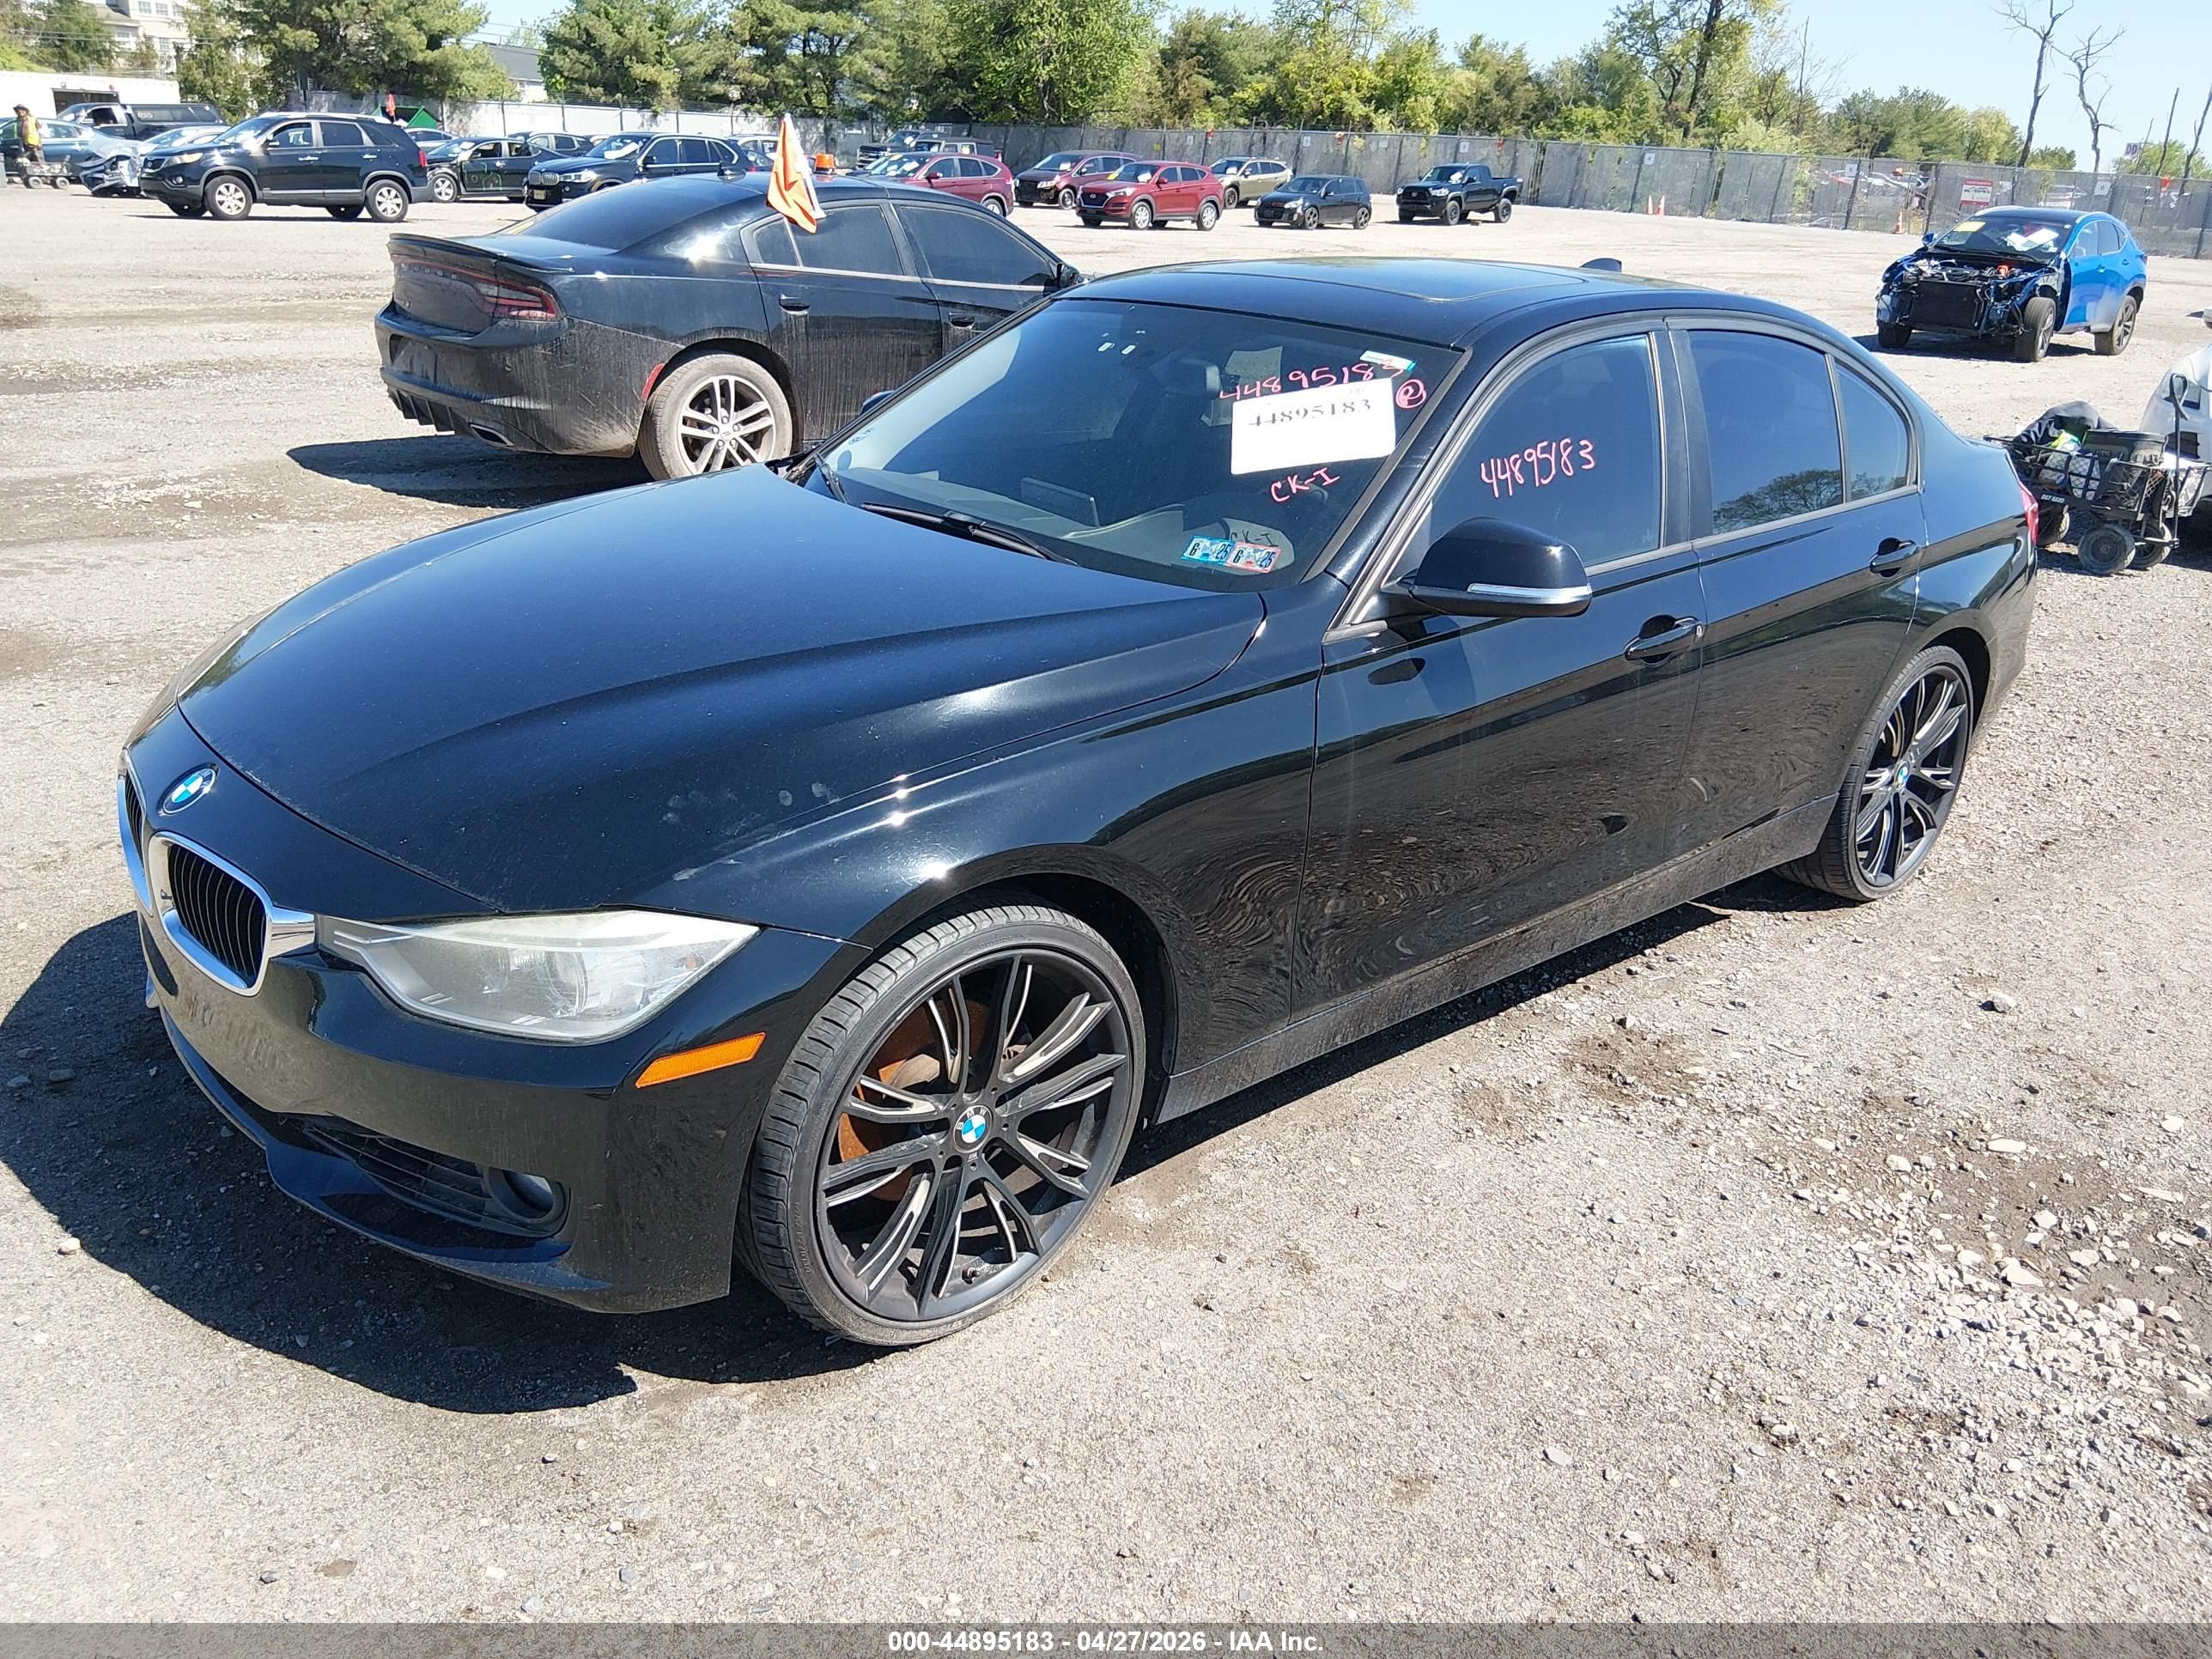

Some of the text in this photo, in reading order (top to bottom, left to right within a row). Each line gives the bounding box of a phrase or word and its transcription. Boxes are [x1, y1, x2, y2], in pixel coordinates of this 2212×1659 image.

[1249, 398, 1371, 426] 44895183
[1480, 438, 1595, 498] 44895183
[1189, 542, 1232, 560] 6 25
[1232, 549, 1276, 568] 6 25
[956, 1107, 988, 1130] BMW
